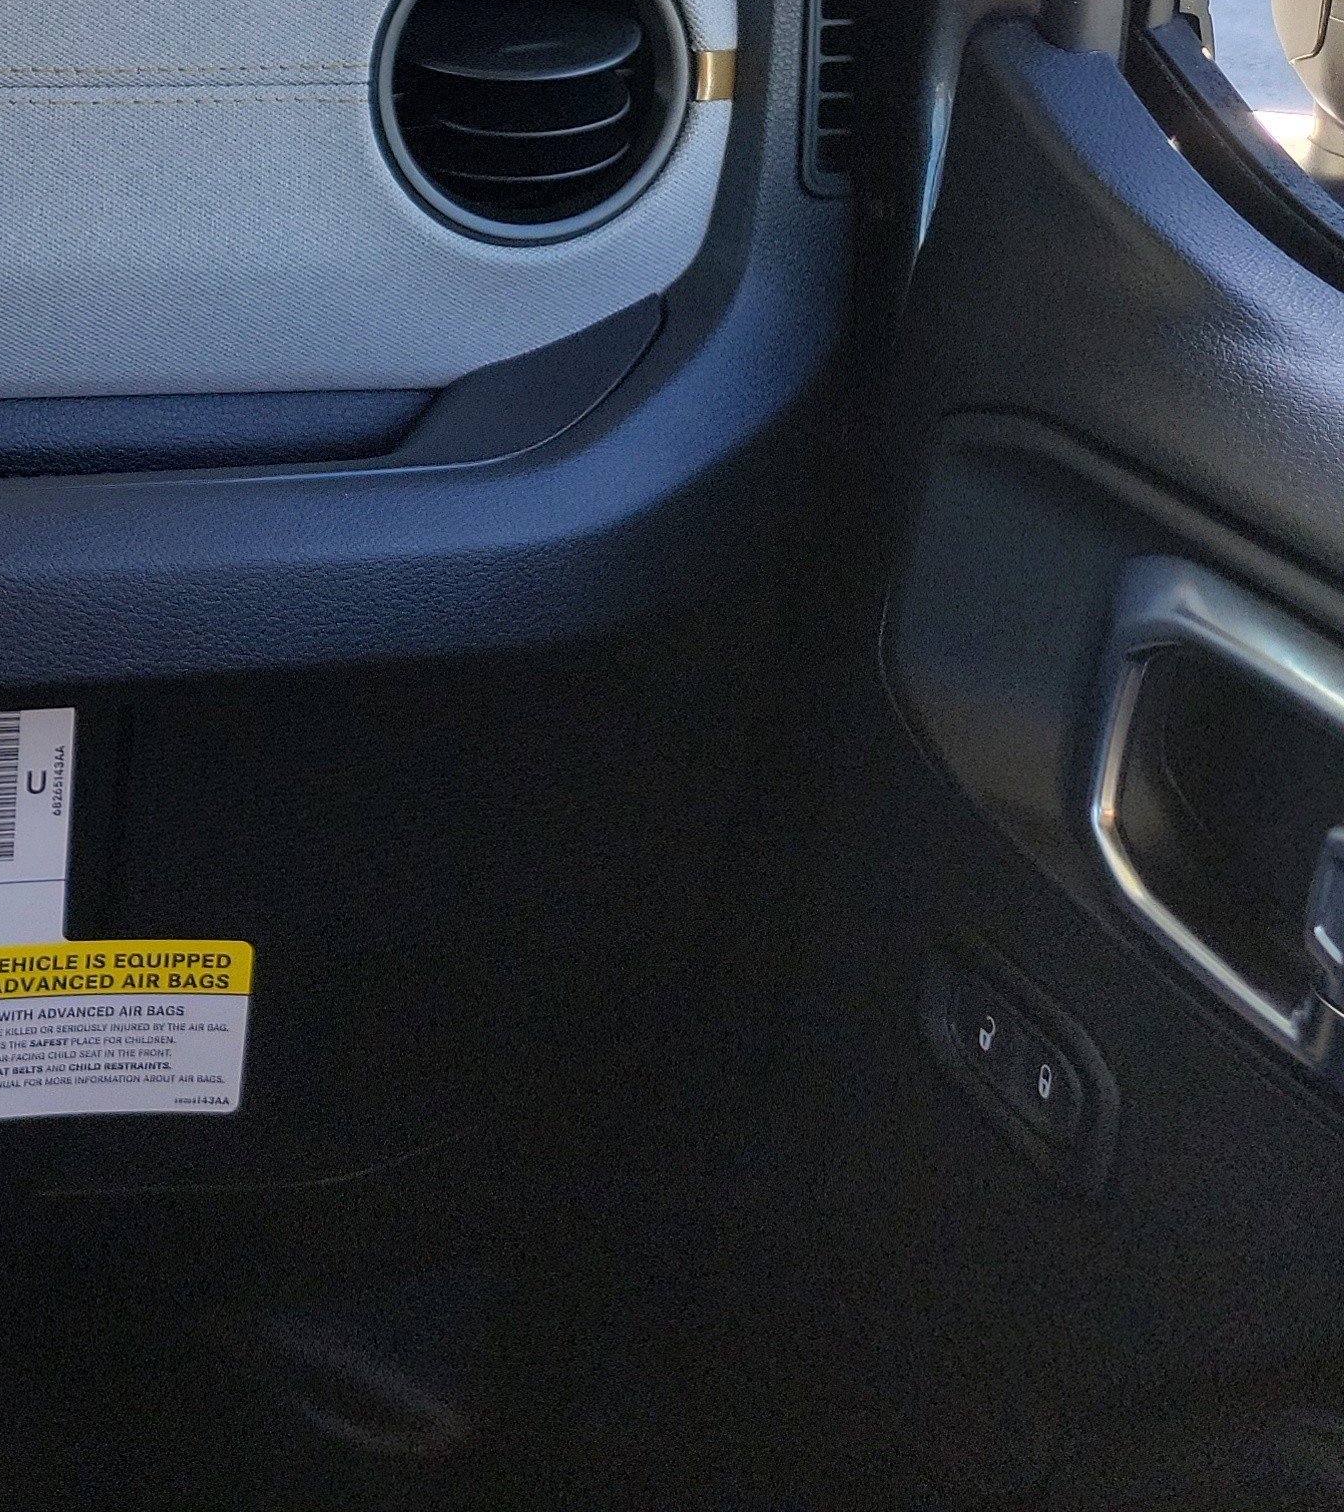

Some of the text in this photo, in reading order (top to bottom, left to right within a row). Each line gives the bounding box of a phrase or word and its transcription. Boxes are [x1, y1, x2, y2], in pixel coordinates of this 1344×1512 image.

[86, 954, 105, 969] IS
[113, 952, 232, 969] EQUIPPED
[122, 973, 160, 989] AIR
[168, 973, 230, 989] BAGS
[38, 1006, 114, 1019] ADVANCED
[119, 1006, 142, 1017] AIR
[147, 1006, 185, 1016] BAGS
[29, 1038, 67, 1047] SAFEST
[71, 1037, 100, 1045] PLACE
[103, 1036, 122, 1044] FOR
[13, 1065, 43, 1074] BELTS
[69, 1063, 100, 1071] CHILD
